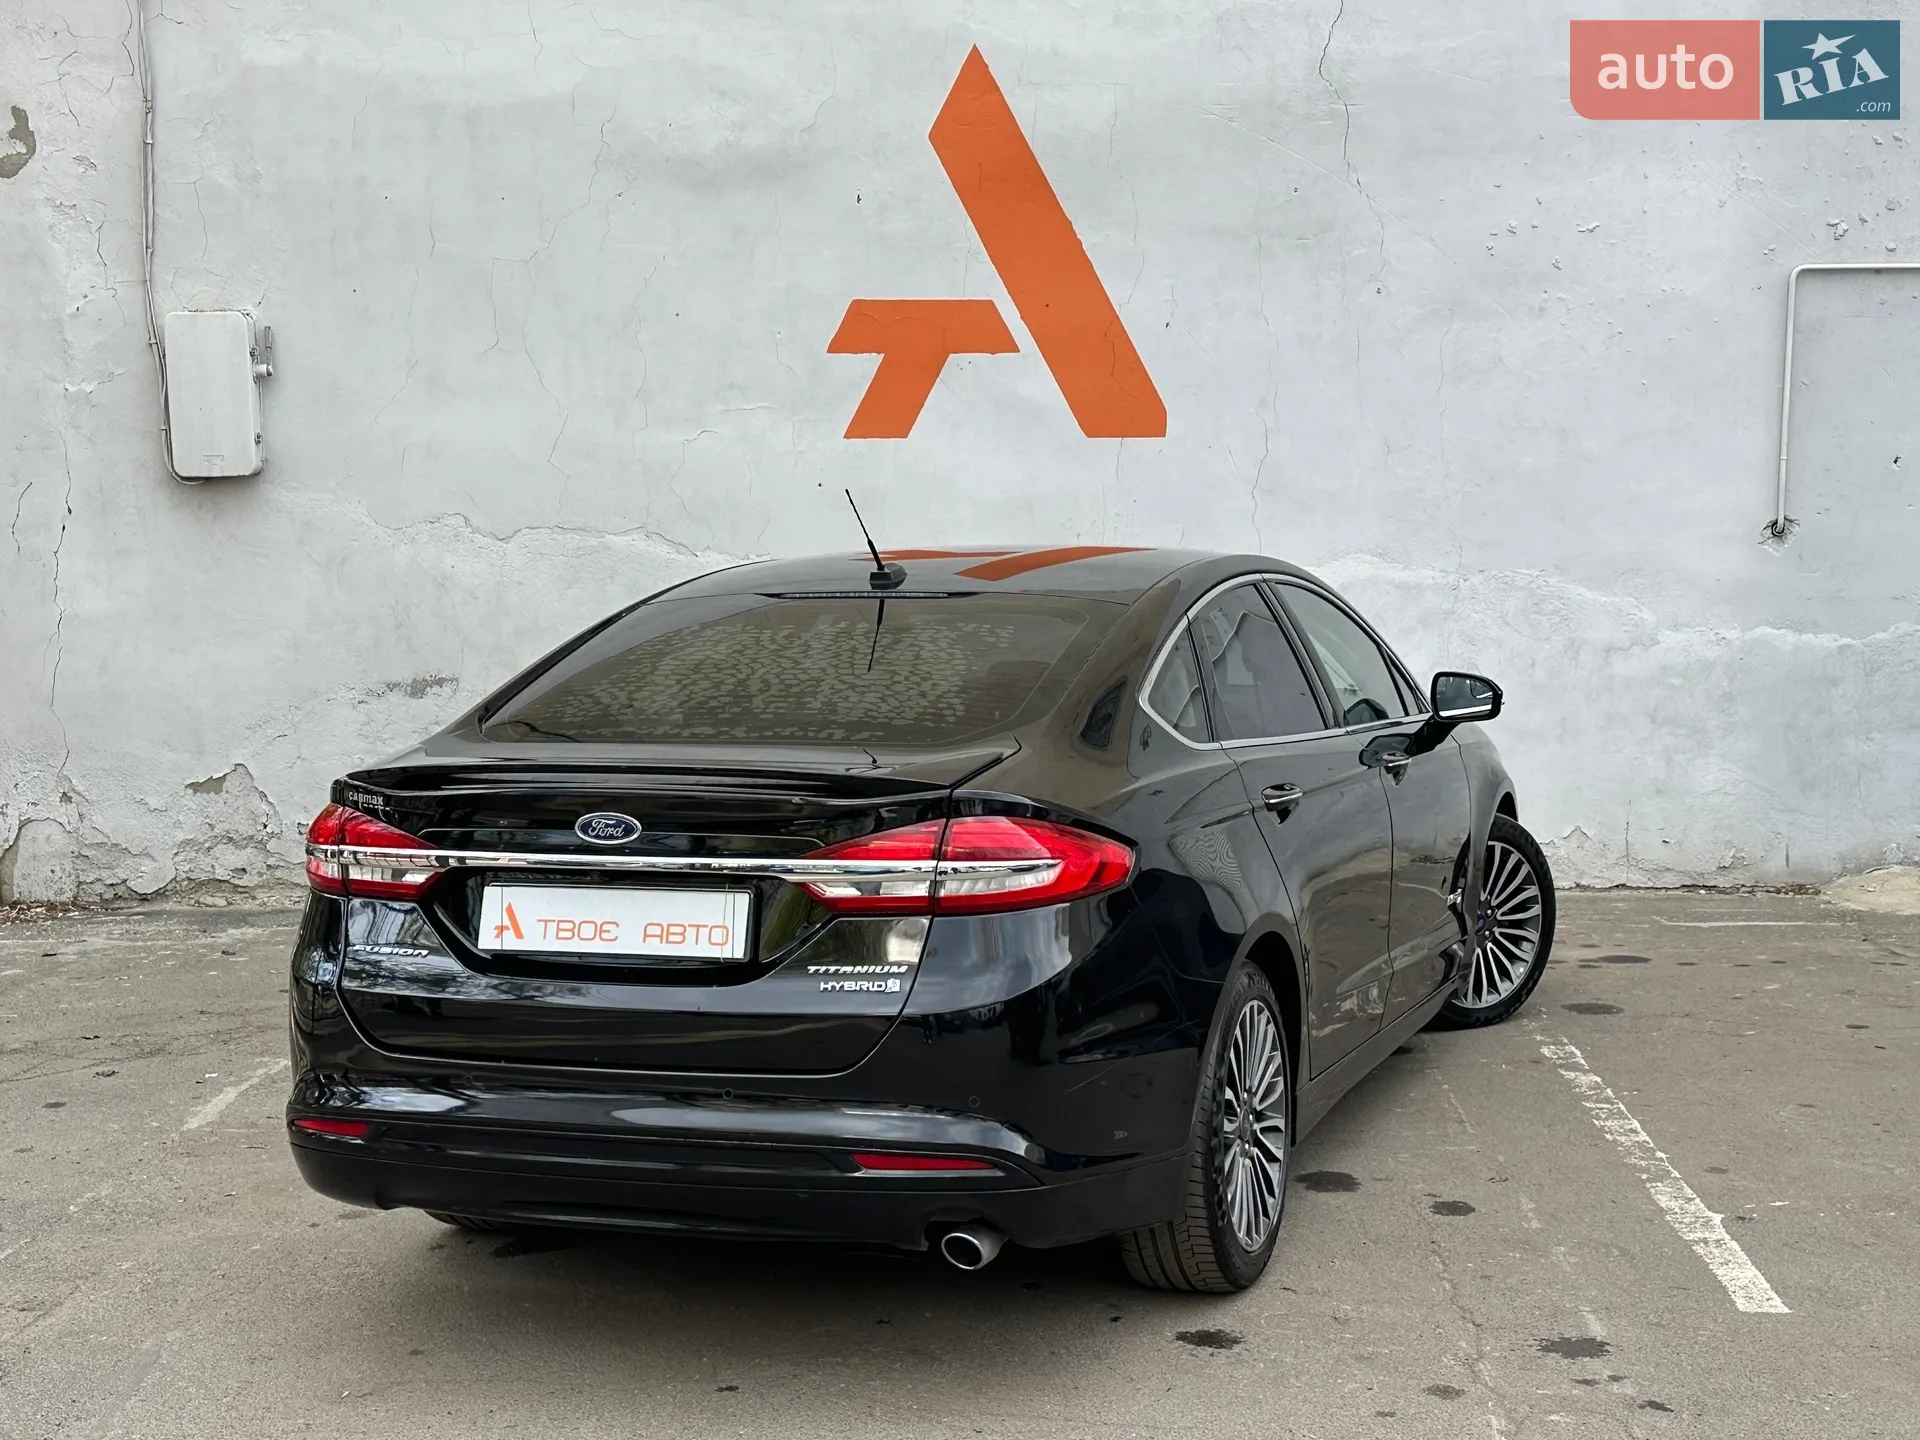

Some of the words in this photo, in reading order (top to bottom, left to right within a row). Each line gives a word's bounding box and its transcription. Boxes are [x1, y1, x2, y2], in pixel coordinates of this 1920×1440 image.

[588, 818, 626, 837] Ford
[537, 919, 620, 942] ТВОЄ
[642, 923, 729, 946] АВТО
[806, 965, 909, 975] TITANIUM
[820, 981, 887, 992] HYBRID
